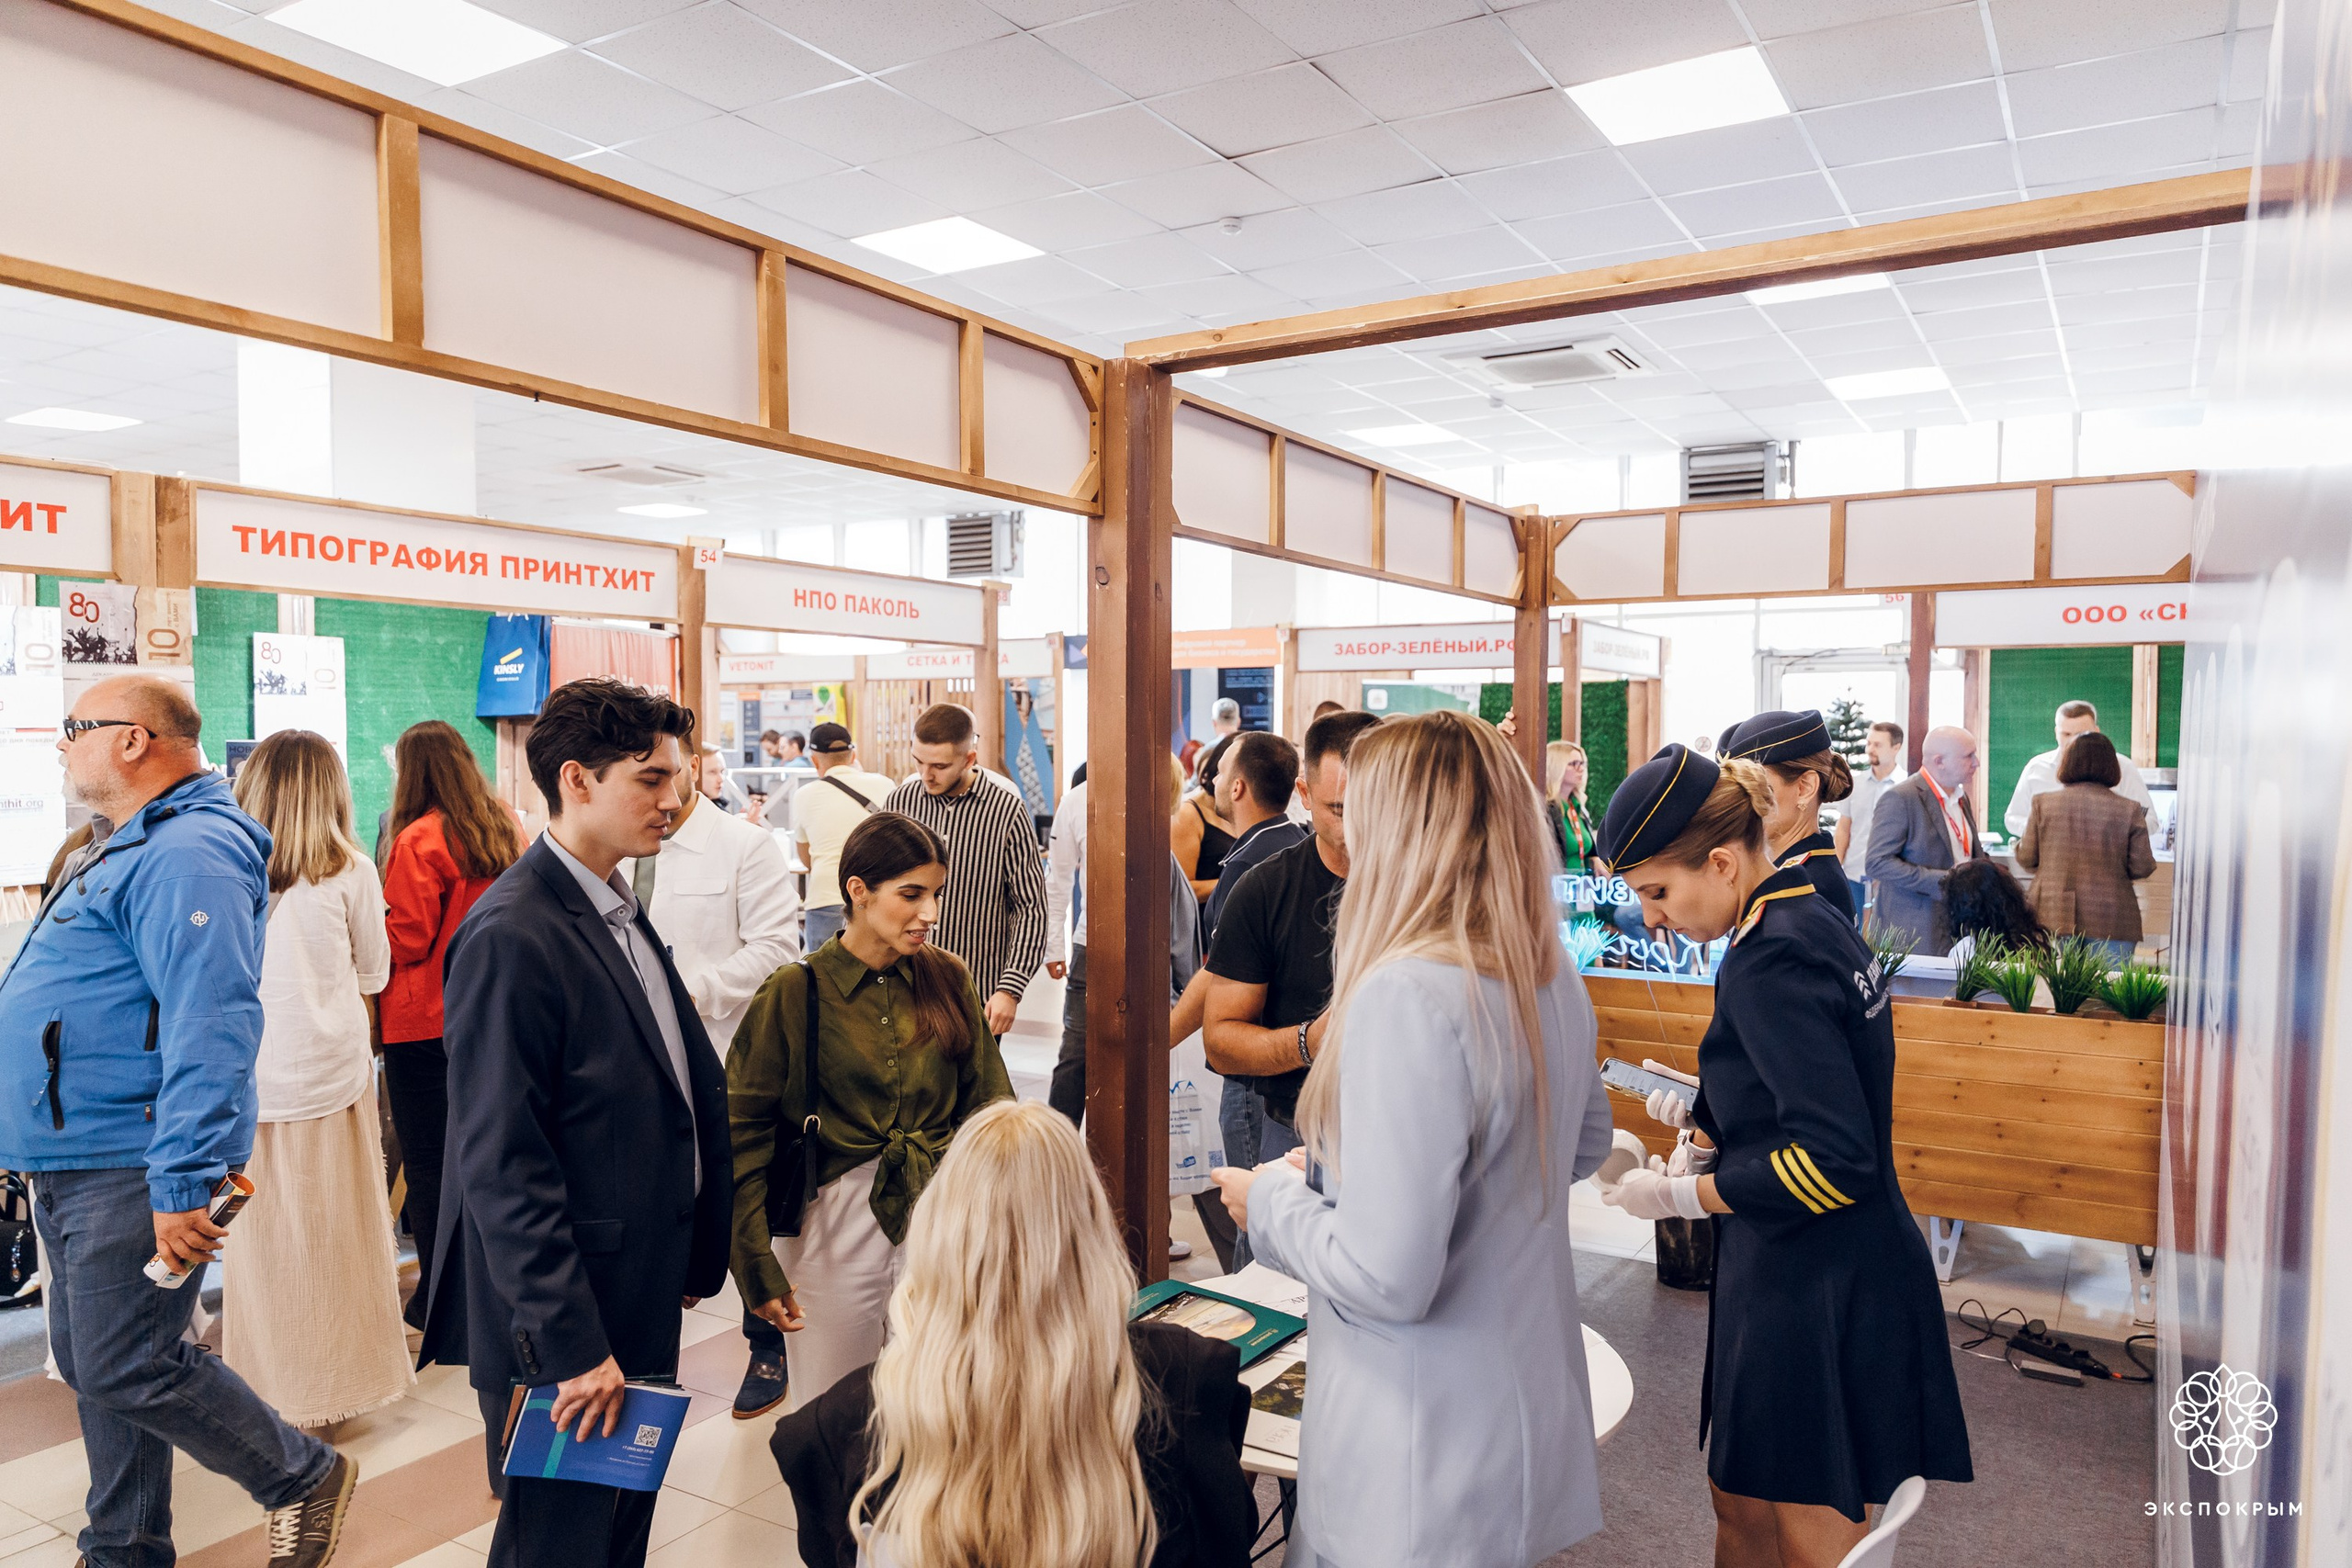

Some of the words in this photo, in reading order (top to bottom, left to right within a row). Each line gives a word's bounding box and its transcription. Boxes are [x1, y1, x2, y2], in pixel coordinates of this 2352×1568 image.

[0, 499, 67, 534] ИТ
[232, 525, 489, 577] ТИПОГРАФИЯ
[501, 556, 656, 592] ПРИНТХИТ
[699, 549, 718, 564] 54
[69, 592, 100, 624] 80
[793, 588, 837, 612] НПО
[843, 594, 920, 619] ПАКОЛЬ
[2062, 604, 2128, 625] ООО
[147, 628, 180, 660] 10
[261, 641, 281, 664] 80
[493, 663, 525, 676] KINSLY
[729, 660, 775, 671] VETONIT
[907, 654, 947, 667] СЕТКА
[952, 654, 961, 666] И
